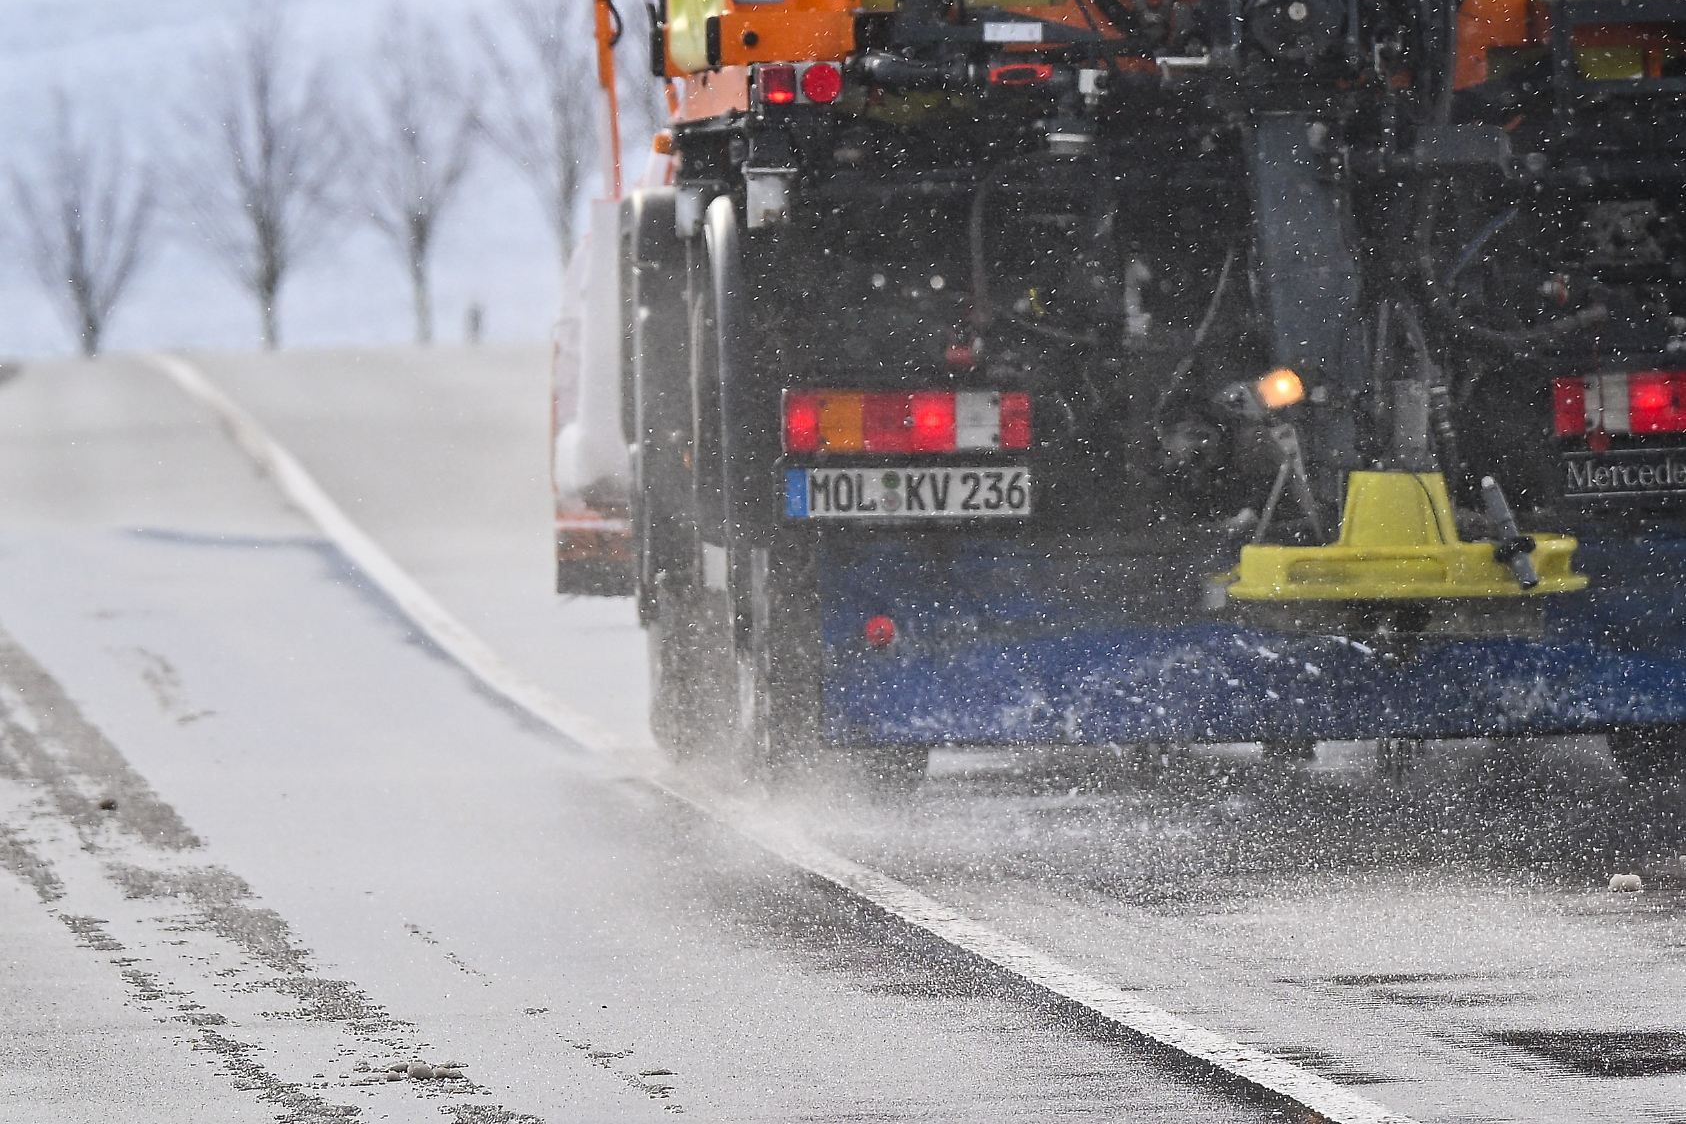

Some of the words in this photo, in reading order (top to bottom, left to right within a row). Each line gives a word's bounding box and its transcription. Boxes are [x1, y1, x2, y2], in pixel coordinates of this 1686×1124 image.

[810, 473, 877, 512] MOL
[905, 473, 950, 511] KV
[960, 472, 1026, 511] 236
